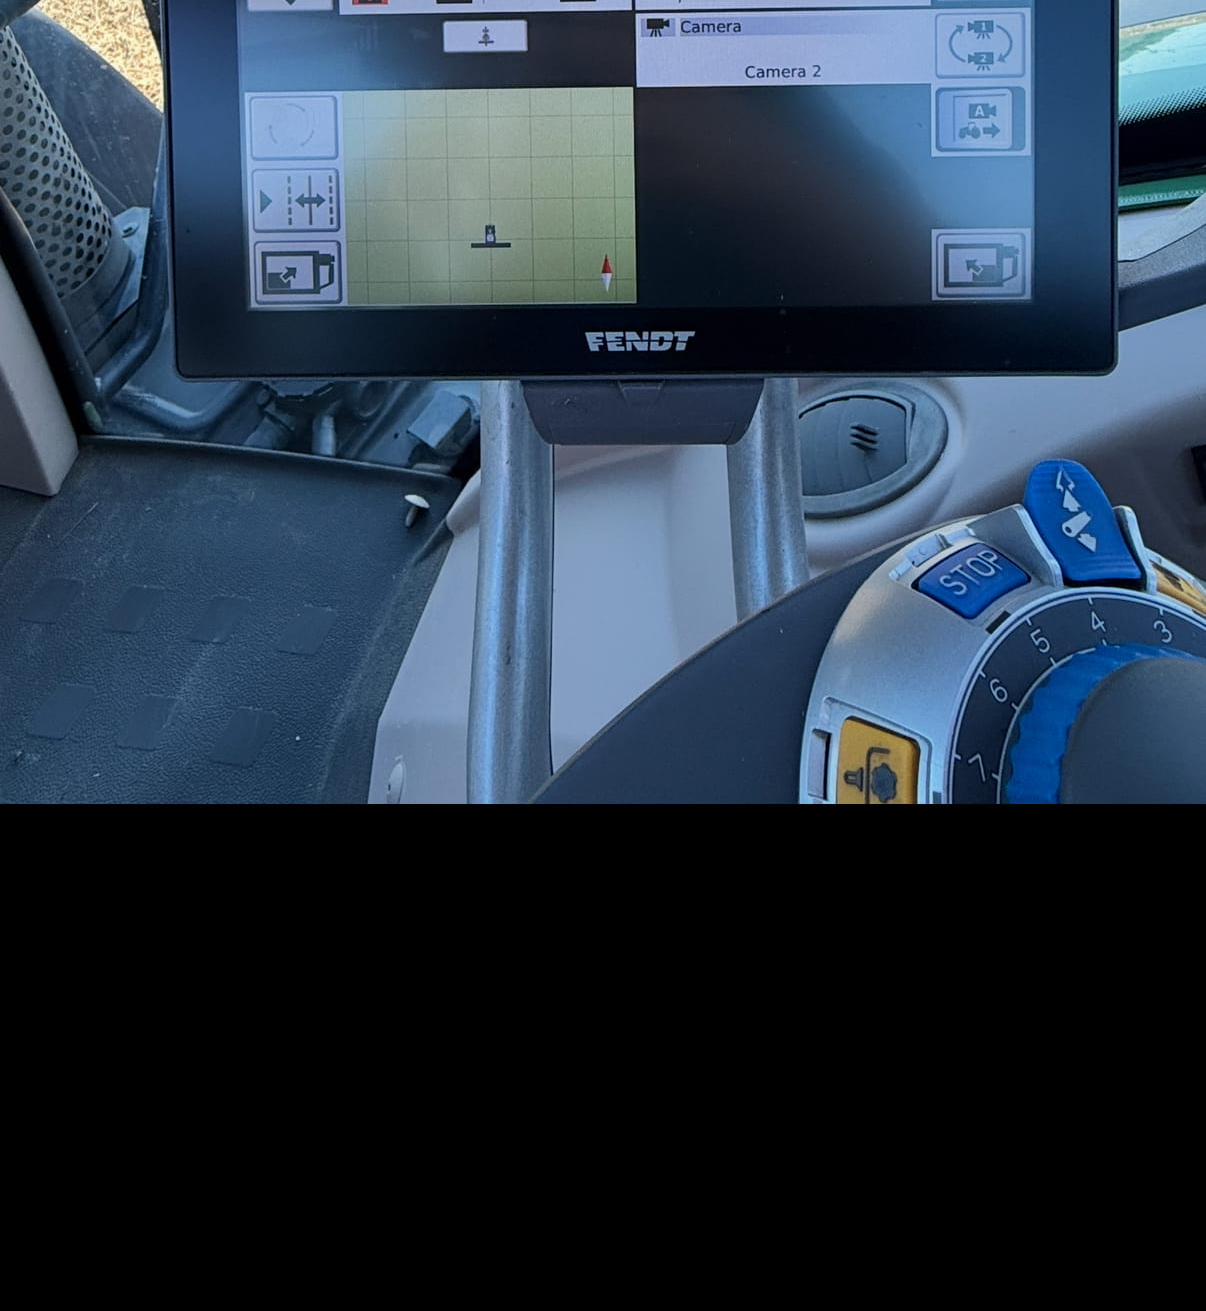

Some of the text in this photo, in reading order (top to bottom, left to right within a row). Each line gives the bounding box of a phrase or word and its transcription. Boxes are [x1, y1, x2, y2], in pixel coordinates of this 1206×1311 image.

[680, 19, 742, 35] Camera
[744, 63, 822, 79] Camera 2
[974, 105, 985, 117] A
[584, 331, 696, 352] FENDT
[939, 549, 1003, 596] STOP
[1089, 610, 1106, 633] 4
[1153, 619, 1174, 644] 3
[1029, 631, 1051, 654] 5
[989, 678, 1009, 703] 6
[967, 753, 987, 782] 7
